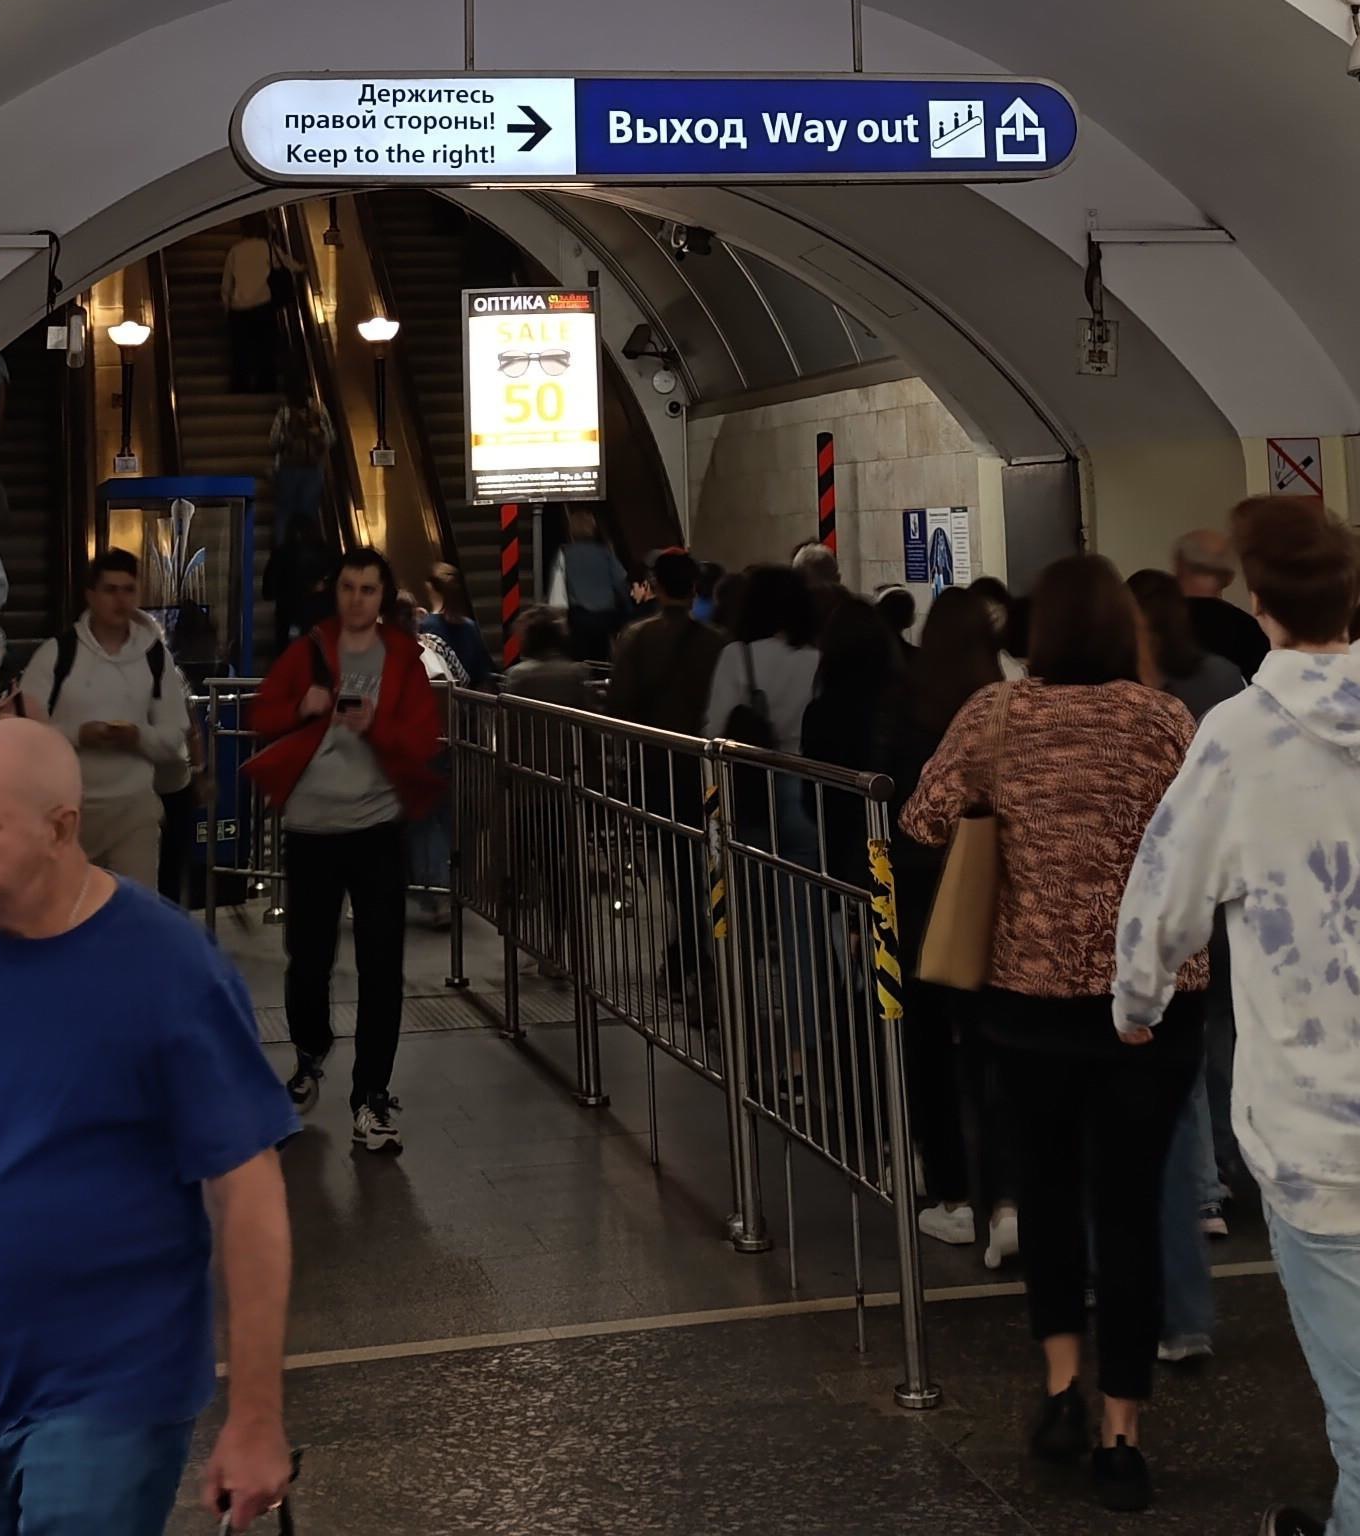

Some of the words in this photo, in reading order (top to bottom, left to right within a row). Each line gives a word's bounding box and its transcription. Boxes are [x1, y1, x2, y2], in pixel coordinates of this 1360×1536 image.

[357, 83, 495, 107] Держитесь
[284, 110, 377, 134] правой
[383, 112, 495, 134] стороны!
[608, 110, 748, 150] Выход
[761, 112, 848, 152] Way
[856, 114, 919, 144] out
[286, 144, 348, 168] Keep
[353, 145, 379, 163] to
[385, 144, 425, 163] the
[432, 144, 495, 168] right!
[473, 295, 547, 312] ОПТИКА
[496, 319, 571, 343] SALE
[504, 381, 566, 424] 50
